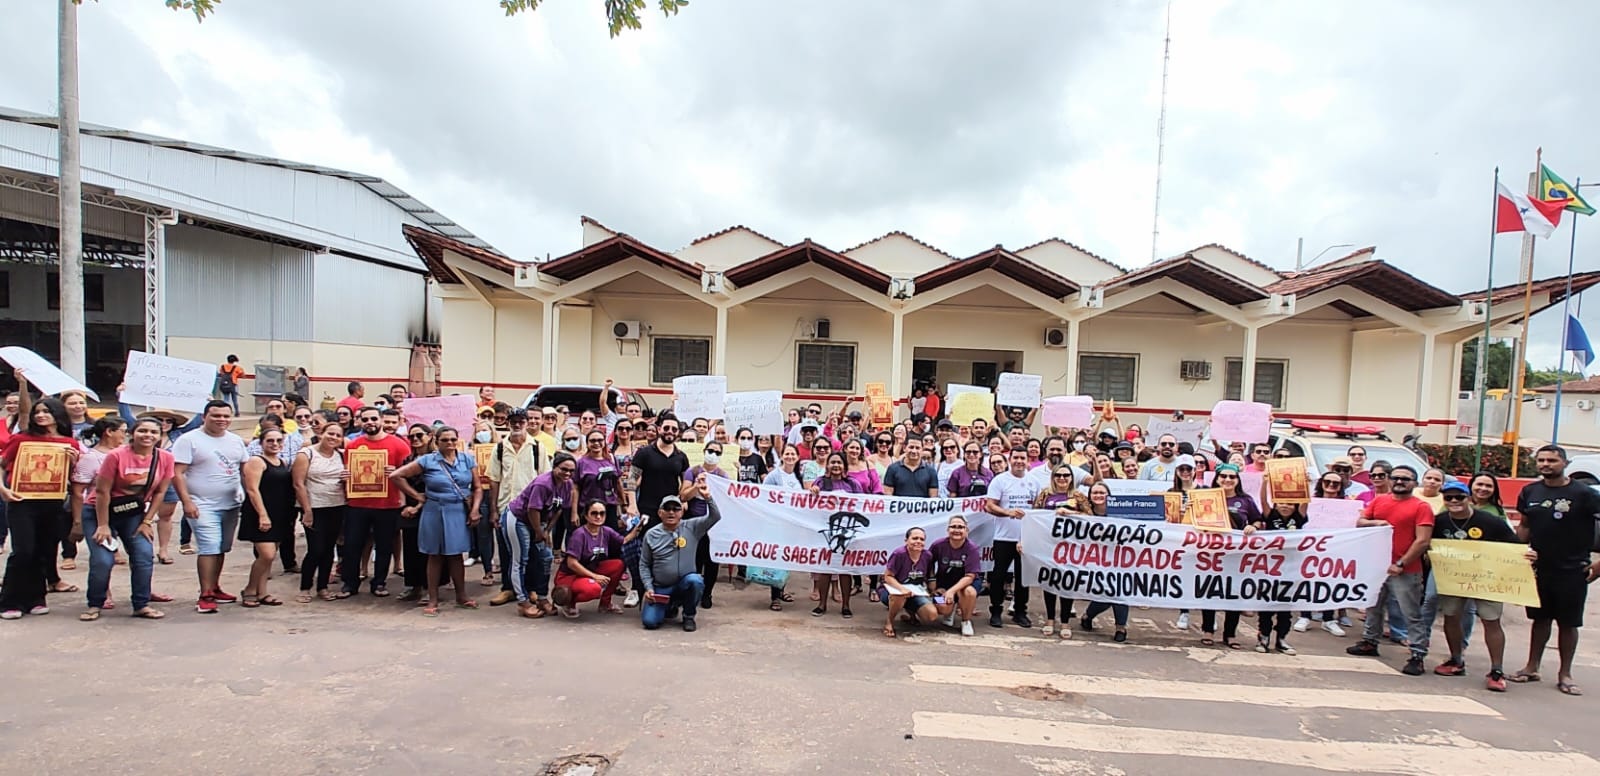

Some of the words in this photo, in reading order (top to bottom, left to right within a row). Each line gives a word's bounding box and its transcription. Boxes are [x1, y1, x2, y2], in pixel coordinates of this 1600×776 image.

[768, 490, 785, 504] SE
[790, 492, 858, 512] INVESTE
[863, 498, 885, 513] NA
[1133, 500, 1157, 508] Franco
[1052, 517, 1163, 546] EDUCAÇÃO
[1298, 535, 1334, 552] DE
[751, 542, 779, 561] QUE
[782, 545, 833, 566] SABEM
[842, 549, 888, 567] MENOS
[1053, 541, 1187, 570] QUALIDADE
[1195, 551, 1226, 572] SE
[1239, 553, 1285, 577] FAZ
[1300, 555, 1357, 580] COM
[1037, 566, 1183, 599] PROFISSIONAIS
[1194, 574, 1369, 604] VALORIZADOS.
